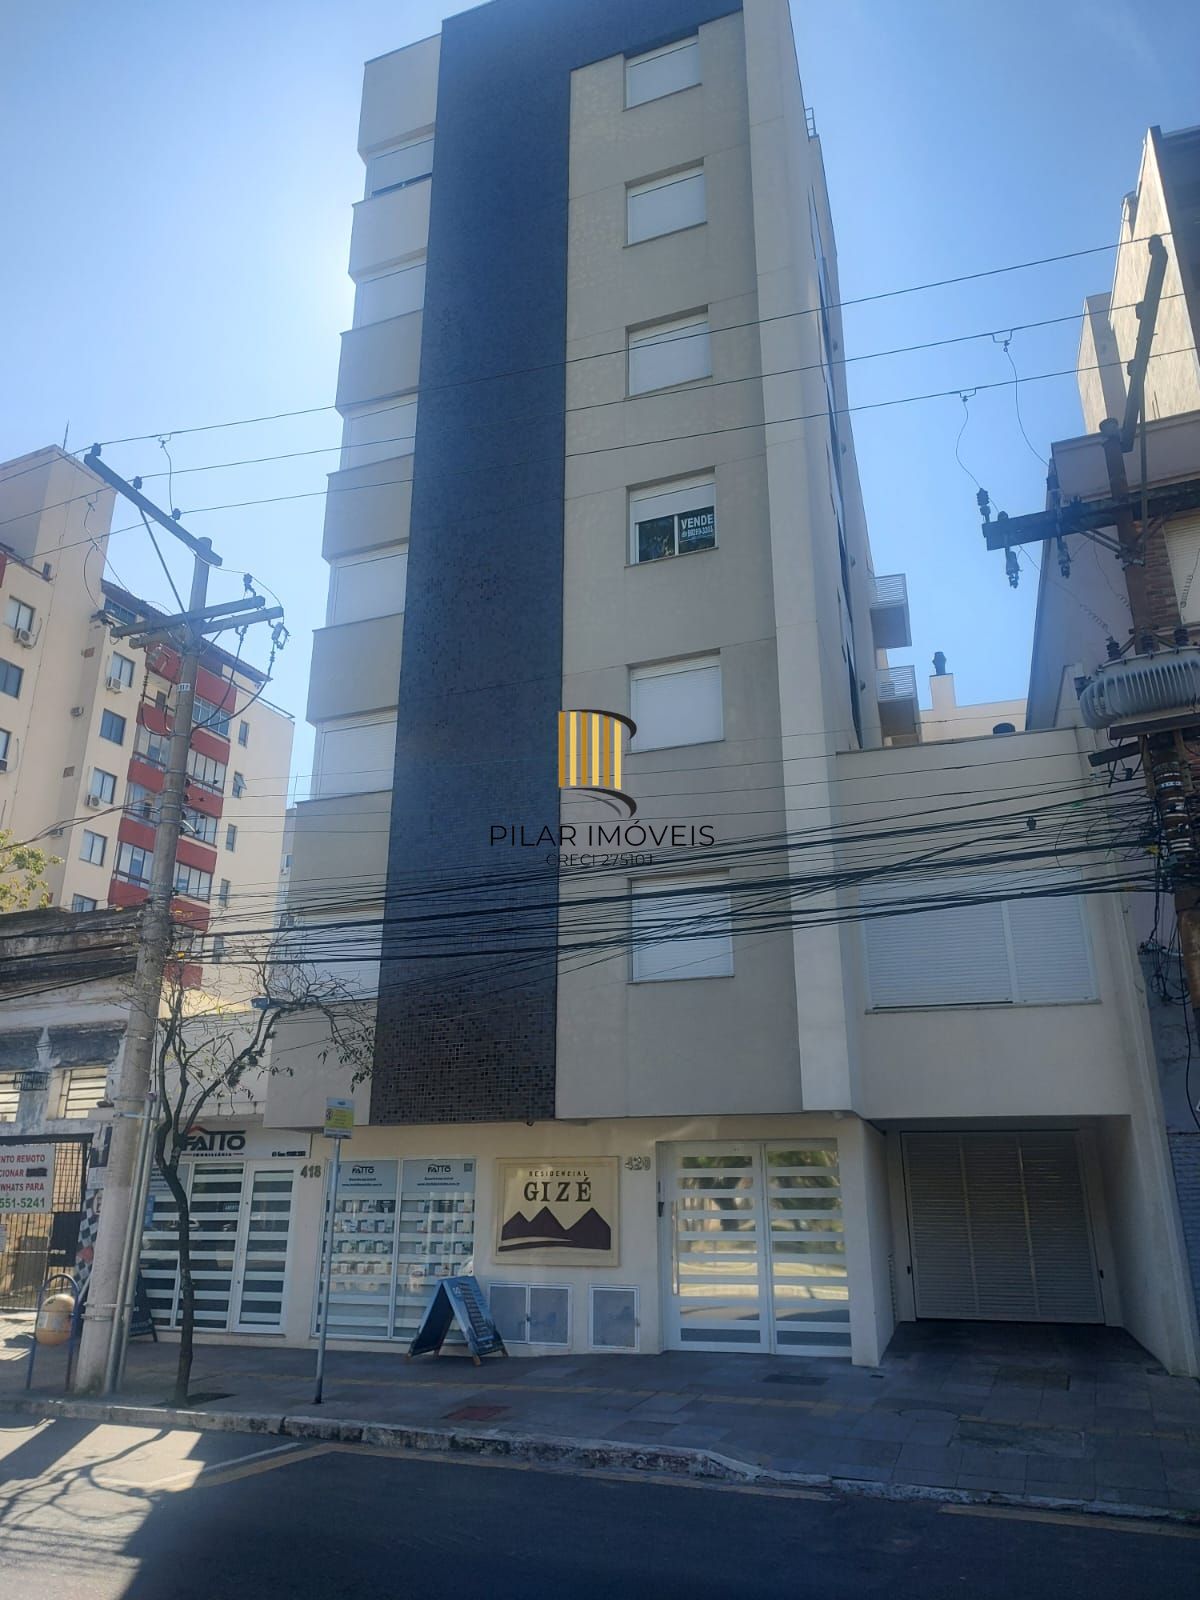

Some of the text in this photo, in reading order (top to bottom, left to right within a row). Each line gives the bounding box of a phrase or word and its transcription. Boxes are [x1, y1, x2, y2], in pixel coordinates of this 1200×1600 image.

[681, 513, 714, 529] VENDE
[182, 1129, 246, 1151] FATTO
[16, 1154, 45, 1163] REMOTO
[300, 1165, 322, 1178] 418
[352, 1165, 375, 1174] FATTO
[427, 1164, 451, 1173] FATTO
[25, 1182, 45, 1191] PARA
[523, 1177, 592, 1202] GIZÉ
